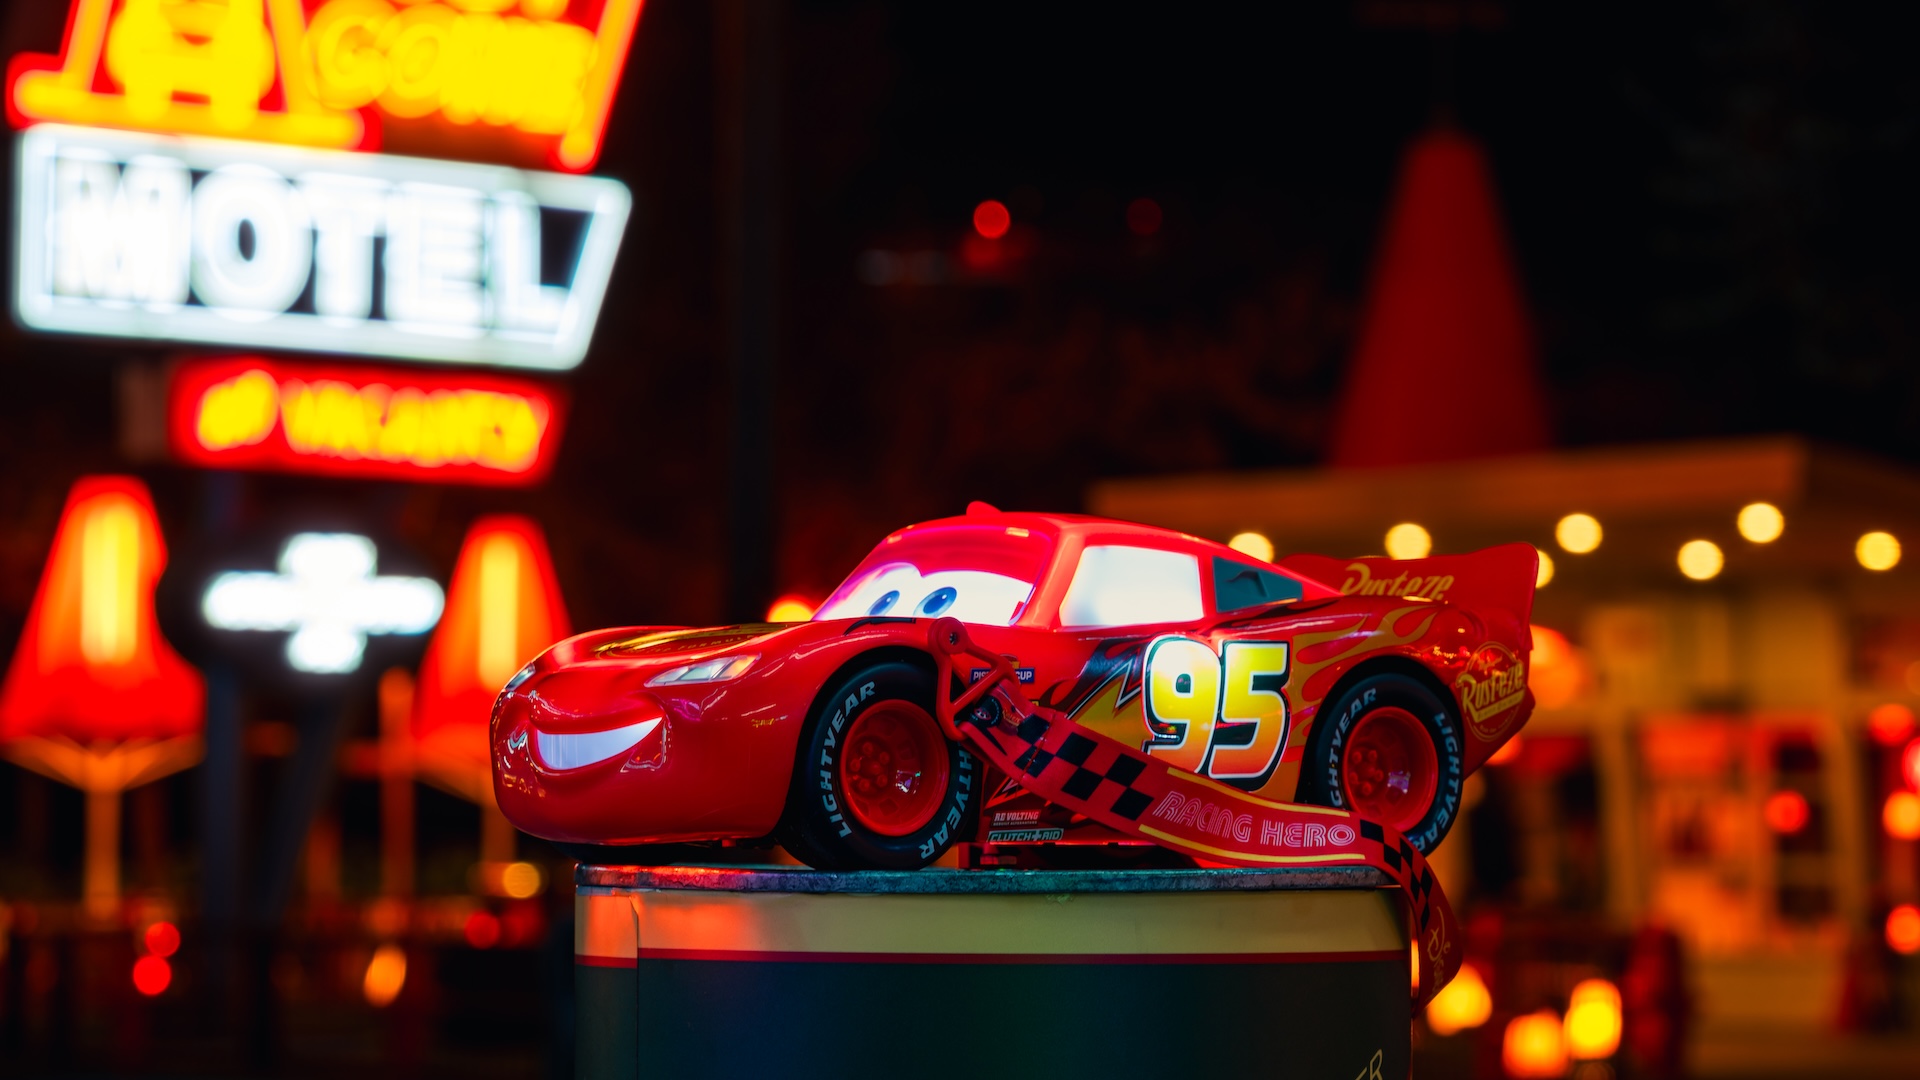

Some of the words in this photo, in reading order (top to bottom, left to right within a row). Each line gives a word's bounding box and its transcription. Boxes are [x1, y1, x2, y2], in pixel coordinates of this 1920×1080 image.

[50, 147, 582, 338] MOTEL
[819, 681, 876, 838] LIGHTYEAR
[1142, 635, 1290, 780] 95
[1328, 688, 1377, 807] GHTYEAR
[918, 746, 973, 859] HTYEAR
[1152, 791, 1252, 843] RACING
[1260, 819, 1355, 848] HERO
[1412, 712, 1460, 852] LIGHTYEAR
